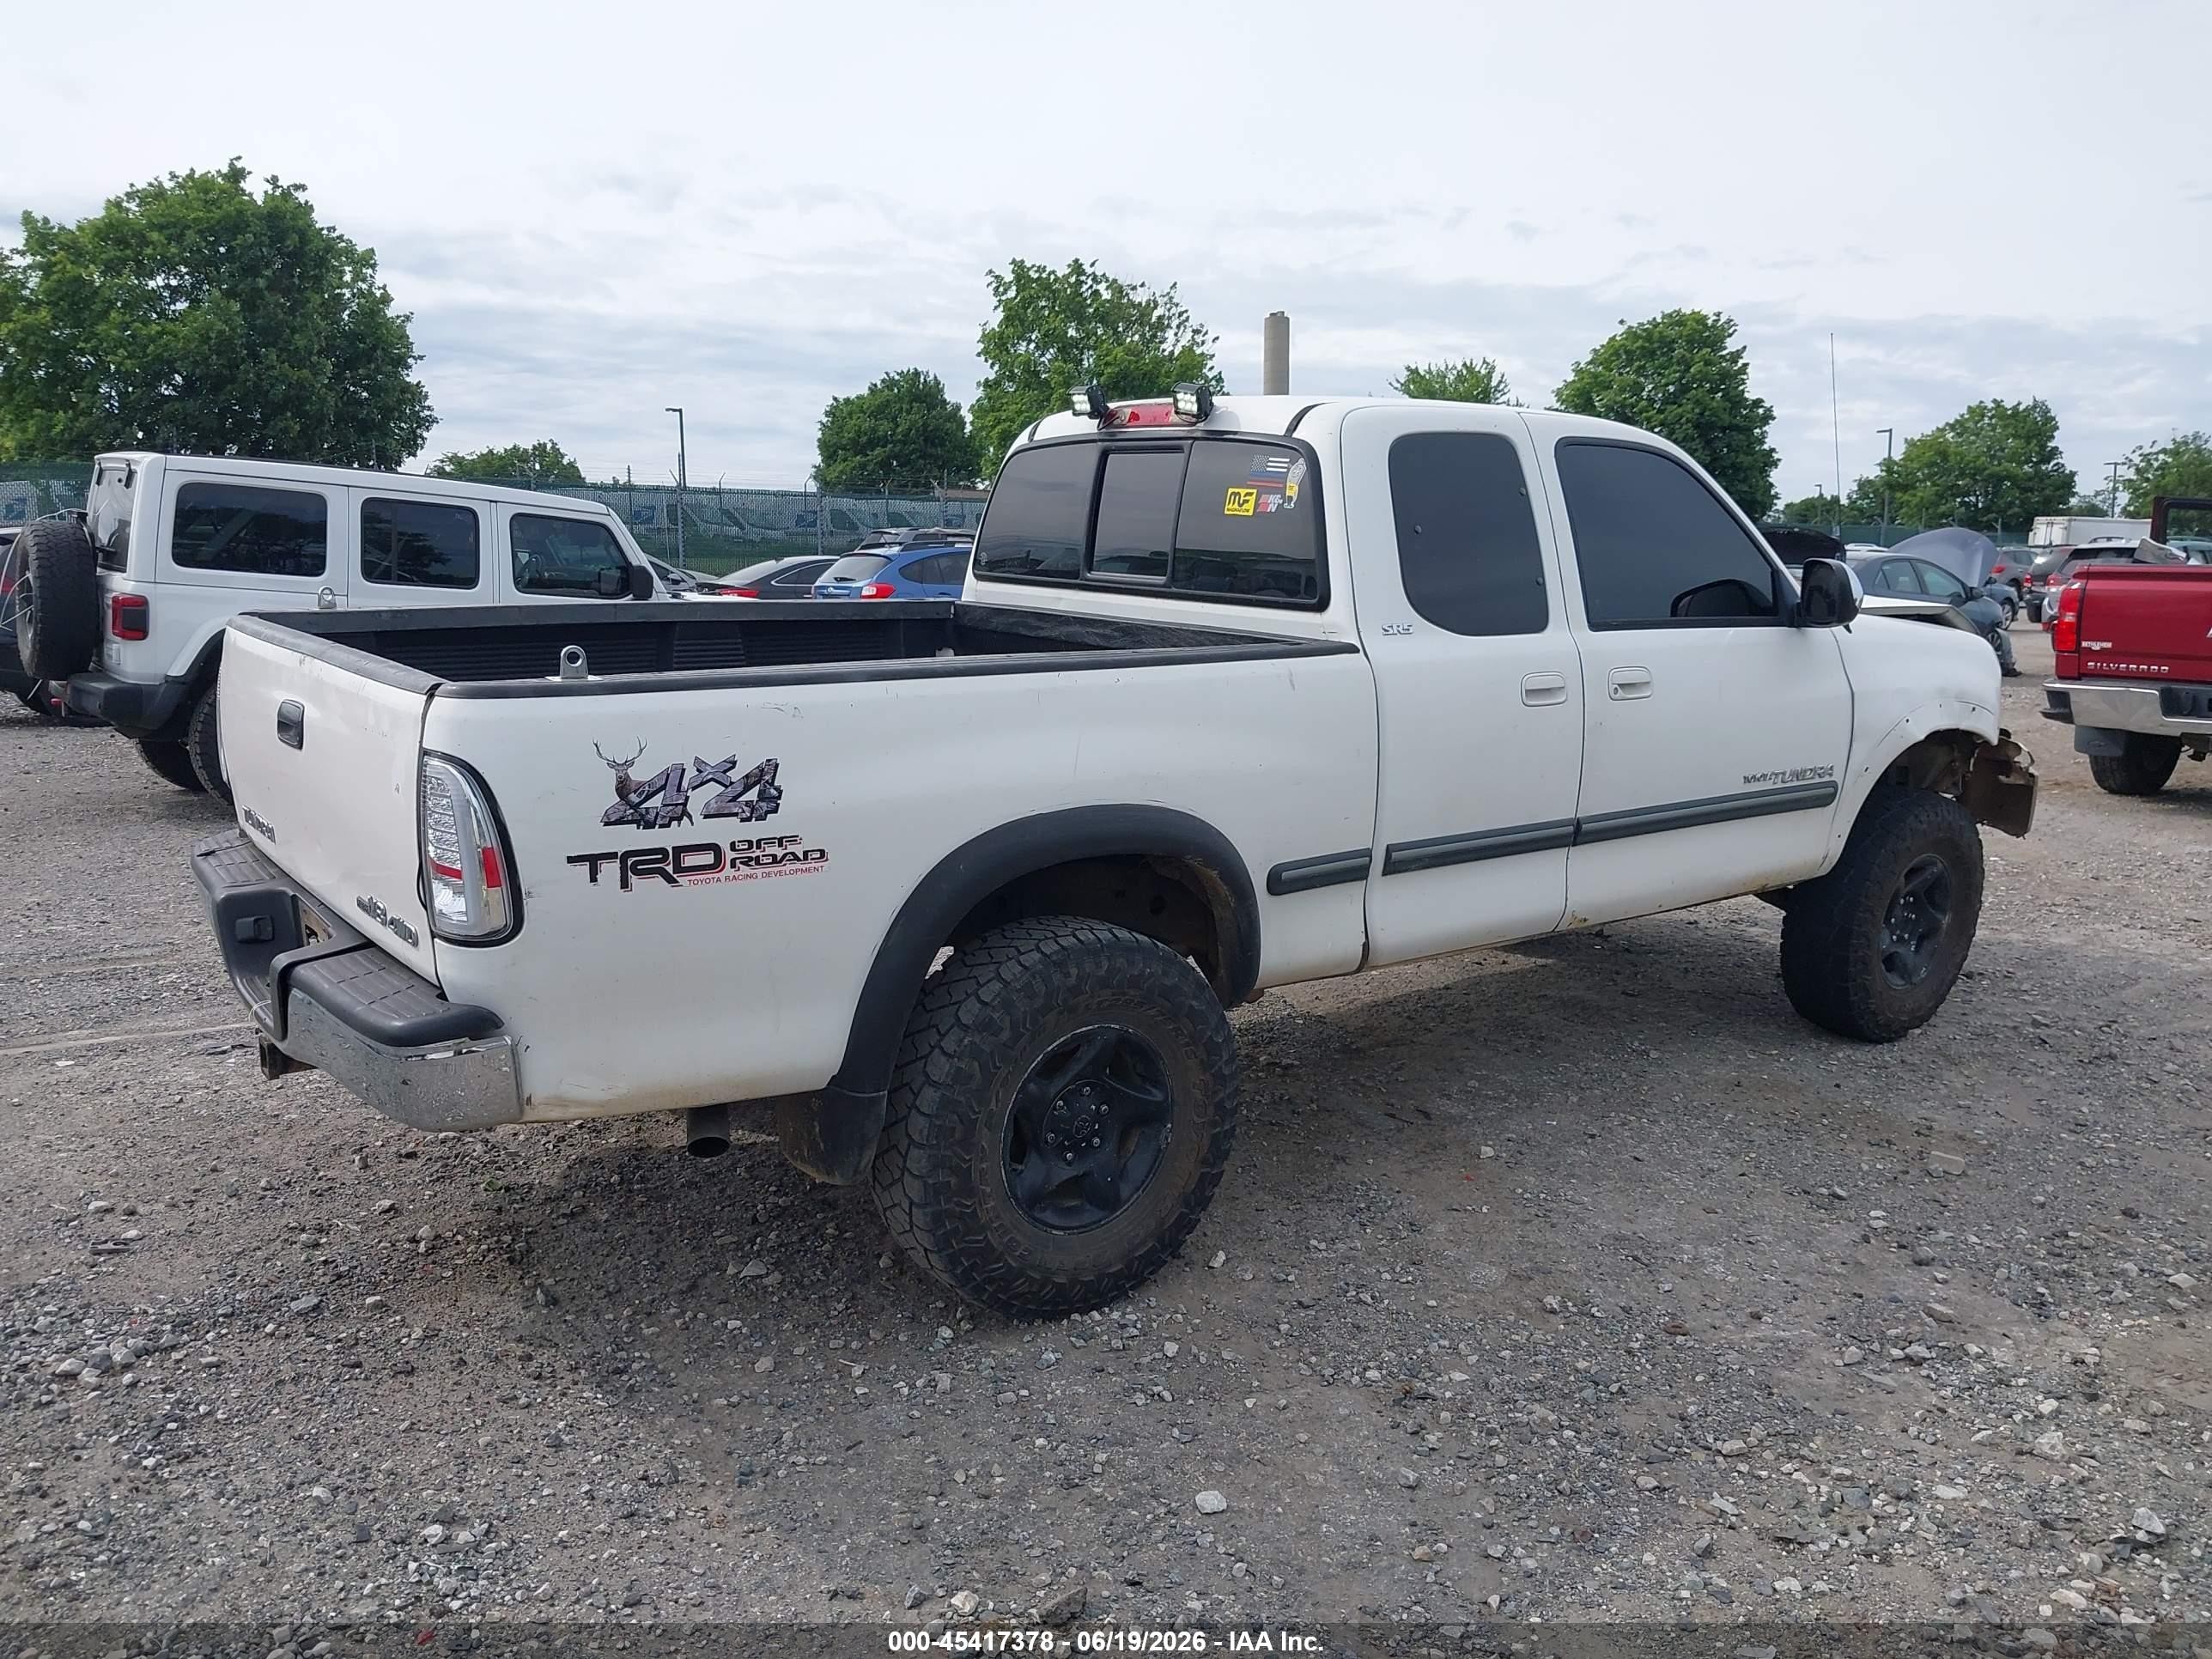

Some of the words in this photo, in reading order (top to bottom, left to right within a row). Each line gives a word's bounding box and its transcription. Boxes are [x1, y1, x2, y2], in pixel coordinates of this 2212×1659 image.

[1382, 623, 1413, 635] SR5
[2087, 662, 2169, 673] SILVERADO
[1770, 763, 1834, 785] TUNDRA
[566, 842, 726, 892] TRD
[729, 835, 803, 854] OFF
[729, 848, 829, 871] ROAD
[687, 876, 722, 887] TOYOTA
[724, 872, 759, 884] RACING
[761, 865, 825, 880] DEVELOPMENT
